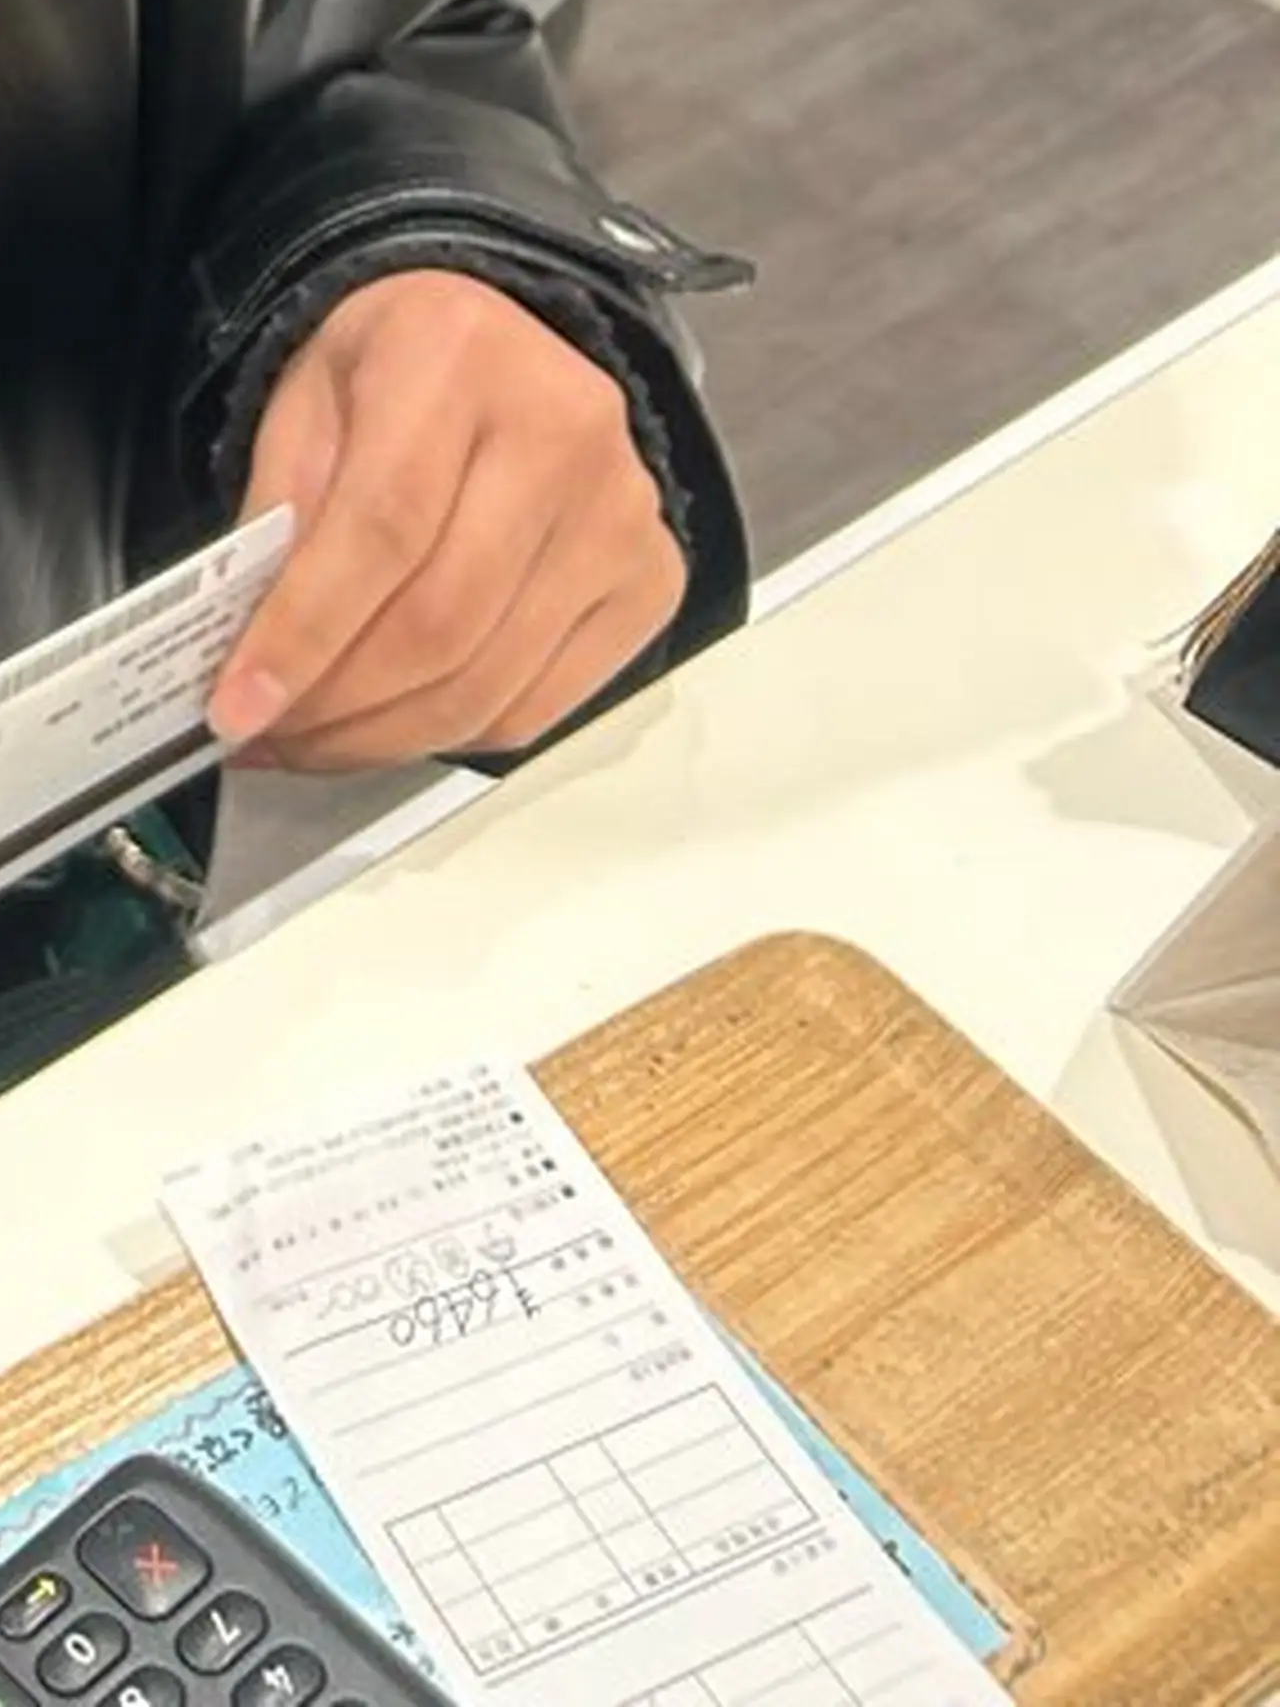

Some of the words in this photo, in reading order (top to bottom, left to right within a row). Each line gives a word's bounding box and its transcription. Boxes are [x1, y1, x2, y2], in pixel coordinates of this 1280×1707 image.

[211, 1610, 239, 1646] 7
[64, 1633, 96, 1664] 0
[261, 1664, 294, 1695] 4
